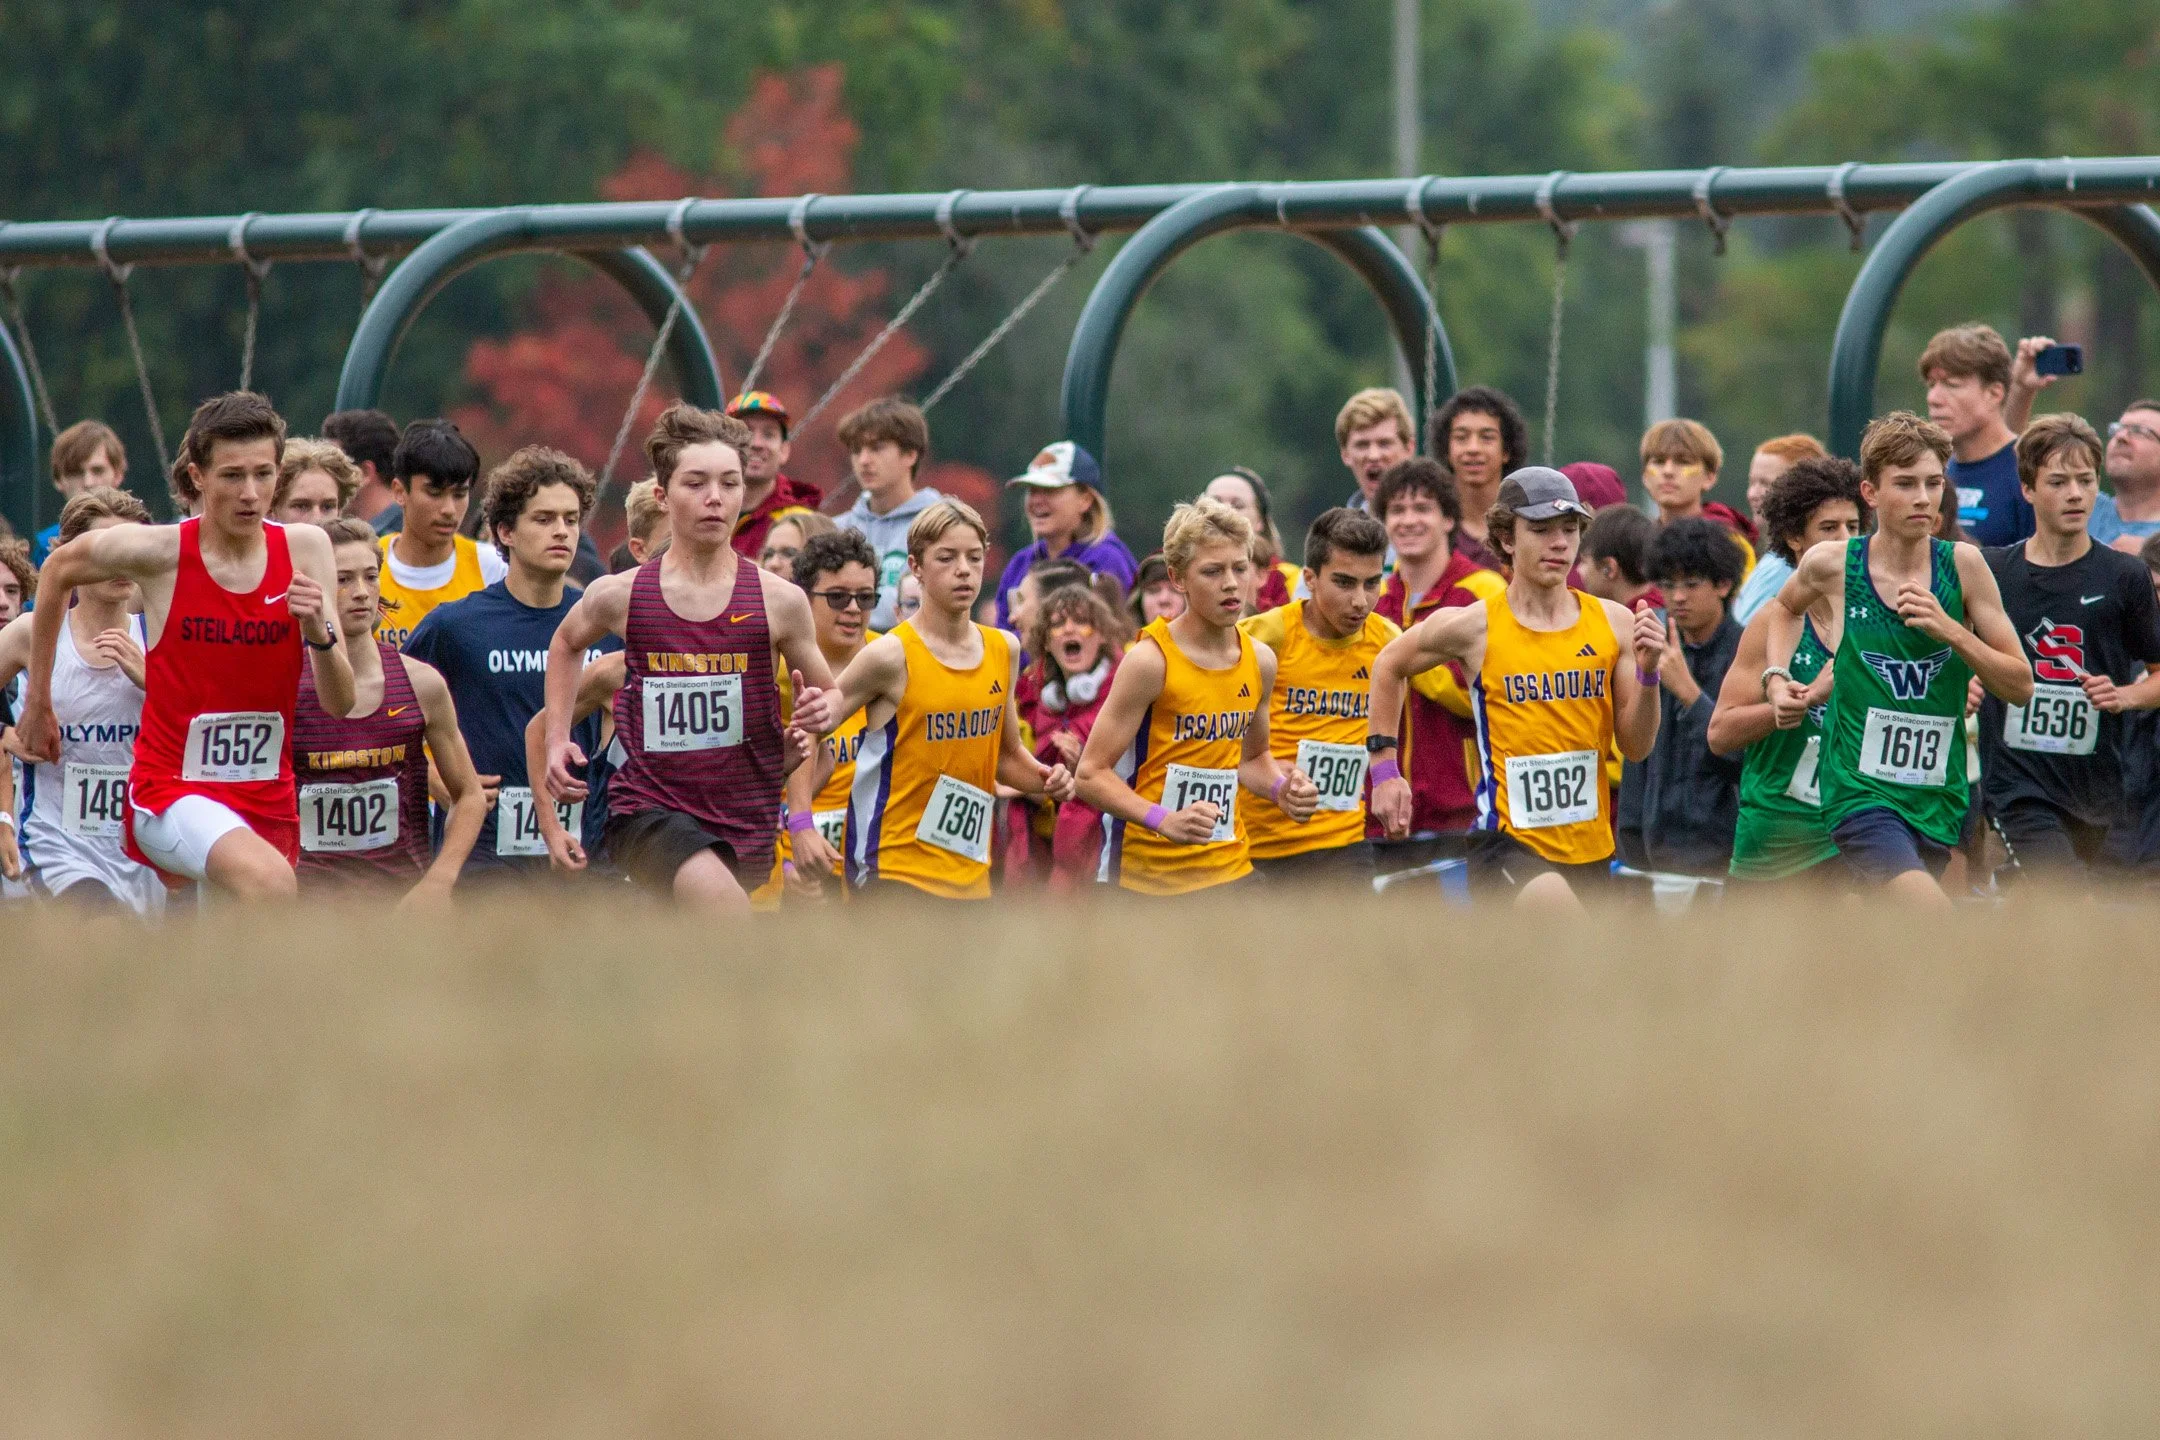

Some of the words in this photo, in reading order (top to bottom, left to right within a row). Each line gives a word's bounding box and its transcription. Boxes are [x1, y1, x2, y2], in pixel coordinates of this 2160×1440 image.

[182, 617, 290, 645] STEILACOOM
[488, 649, 549, 673] OLYM
[646, 651, 748, 673] KINGSTON
[666, 681, 708, 689] Steilacoom
[710, 679, 732, 687] Invite
[1504, 669, 1606, 704] ISSAQUAH
[1882, 660, 1933, 700] W
[655, 690, 730, 736] 1405
[1874, 712, 1891, 721] Fort
[1892, 715, 1931, 727] Steilacoom
[2021, 697, 2089, 740] 1536
[201, 724, 272, 767] 1552
[308, 744, 406, 770] KINGSTON
[1511, 760, 1528, 768] Fort
[1529, 757, 1571, 768] Steilacoom
[1572, 754, 1590, 763] Invite
[1880, 724, 1941, 771] 1613
[72, 766, 88, 775] Fort
[1173, 768, 1190, 778] Fort
[1307, 755, 1361, 797] 1360
[306, 786, 323, 794] Fort
[324, 786, 368, 795] Steilacoom
[1519, 765, 1588, 812] 1362
[312, 793, 387, 837] 1402
[513, 801, 572, 841] 143
[936, 792, 986, 845] 1361
